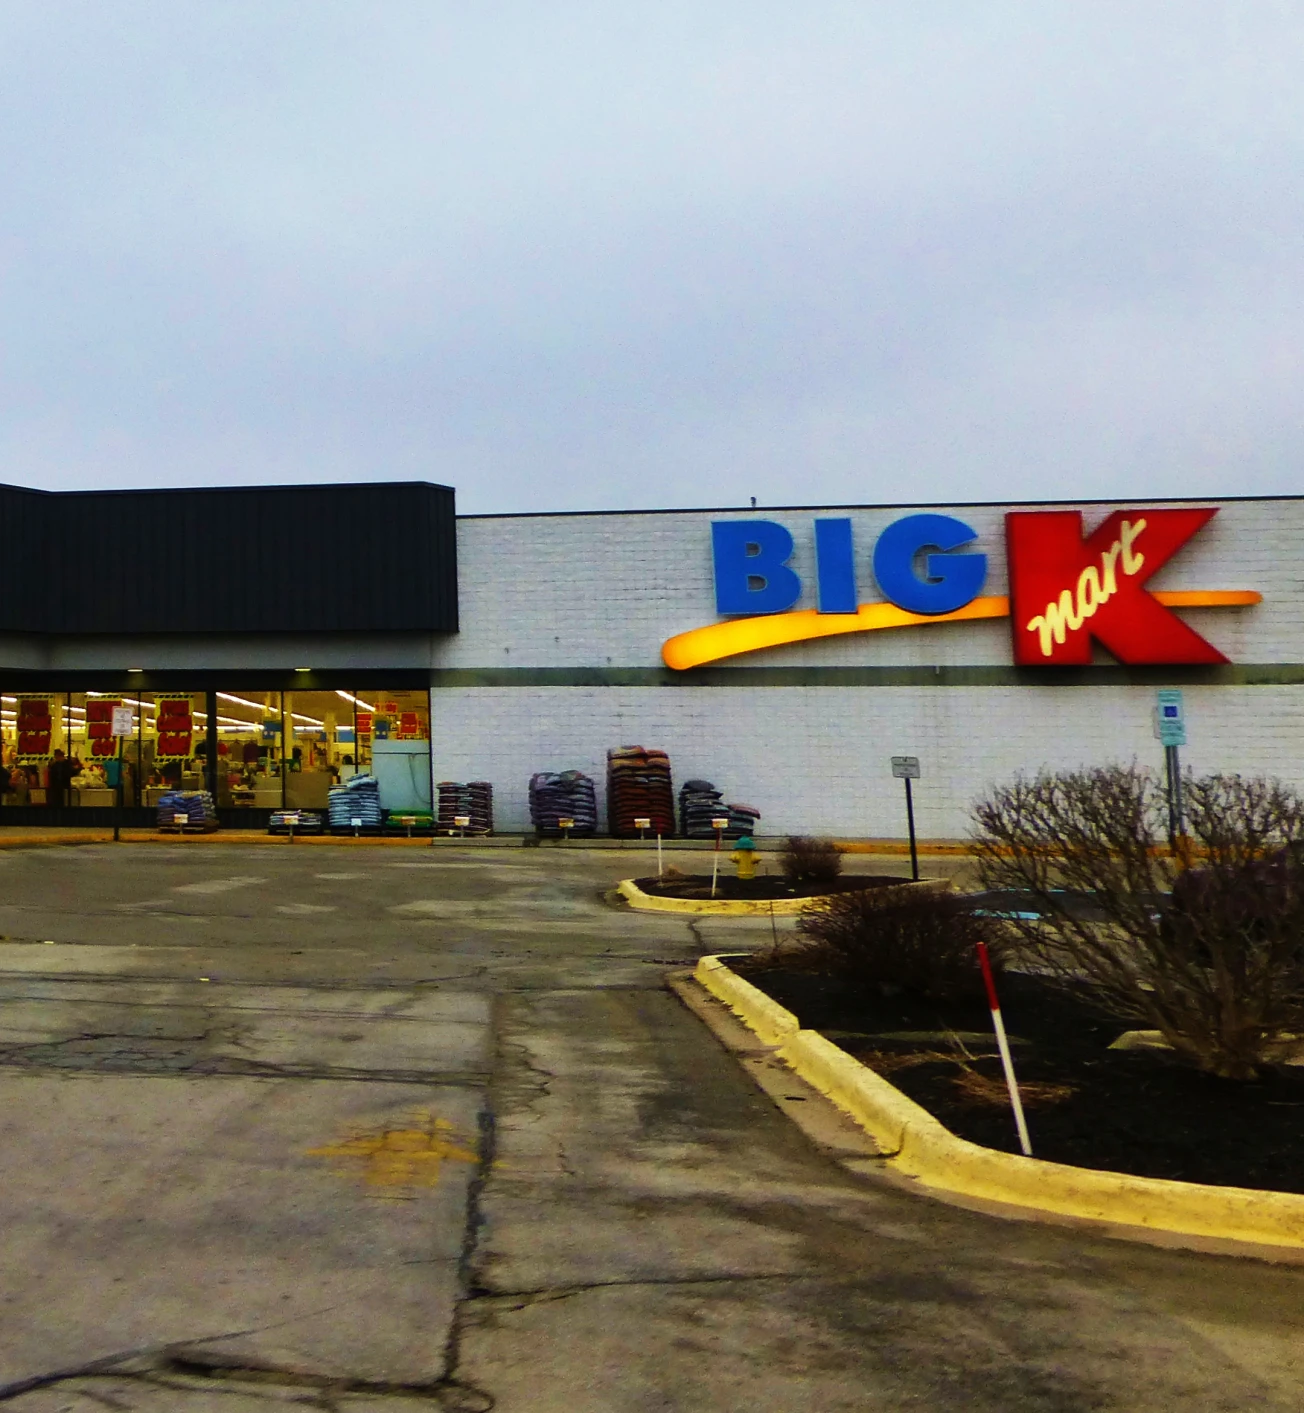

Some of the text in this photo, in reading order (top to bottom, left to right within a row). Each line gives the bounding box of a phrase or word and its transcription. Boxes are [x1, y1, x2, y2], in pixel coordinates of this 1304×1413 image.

[710, 507, 1233, 665] BIG K
[1026, 518, 1147, 657] mart
